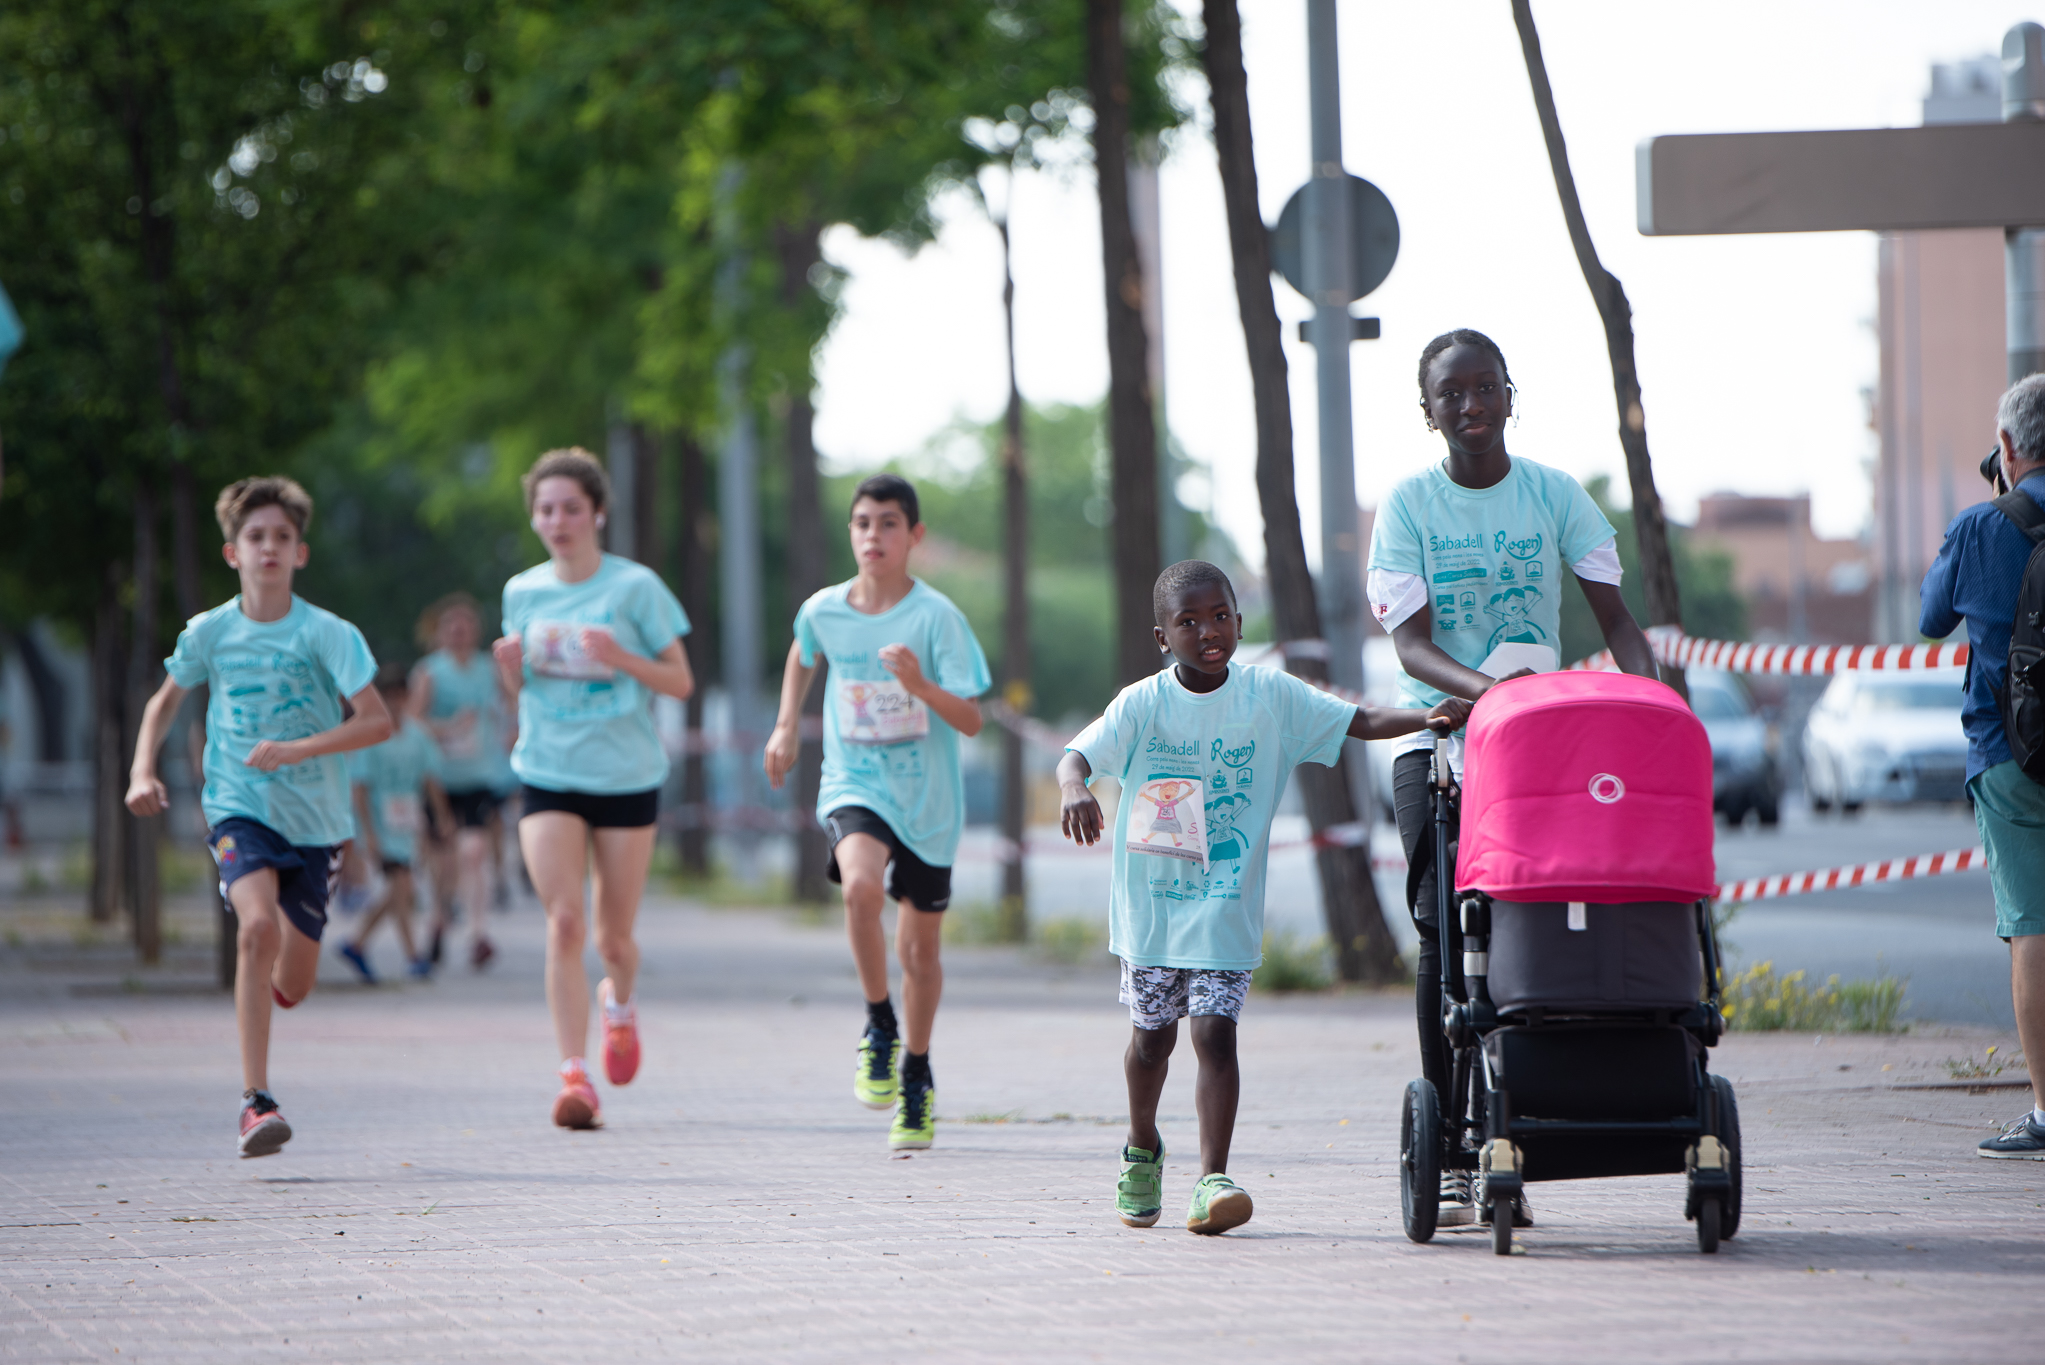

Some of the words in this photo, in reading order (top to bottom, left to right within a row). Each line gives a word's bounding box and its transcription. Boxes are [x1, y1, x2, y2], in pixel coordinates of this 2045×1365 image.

[1429, 533, 1483, 552] Sabadell
[1467, 558, 1480, 566] 2022
[875, 693, 914, 713] 224
[1146, 736, 1200, 757] Sabadell
[1166, 764, 1176, 772] maig
